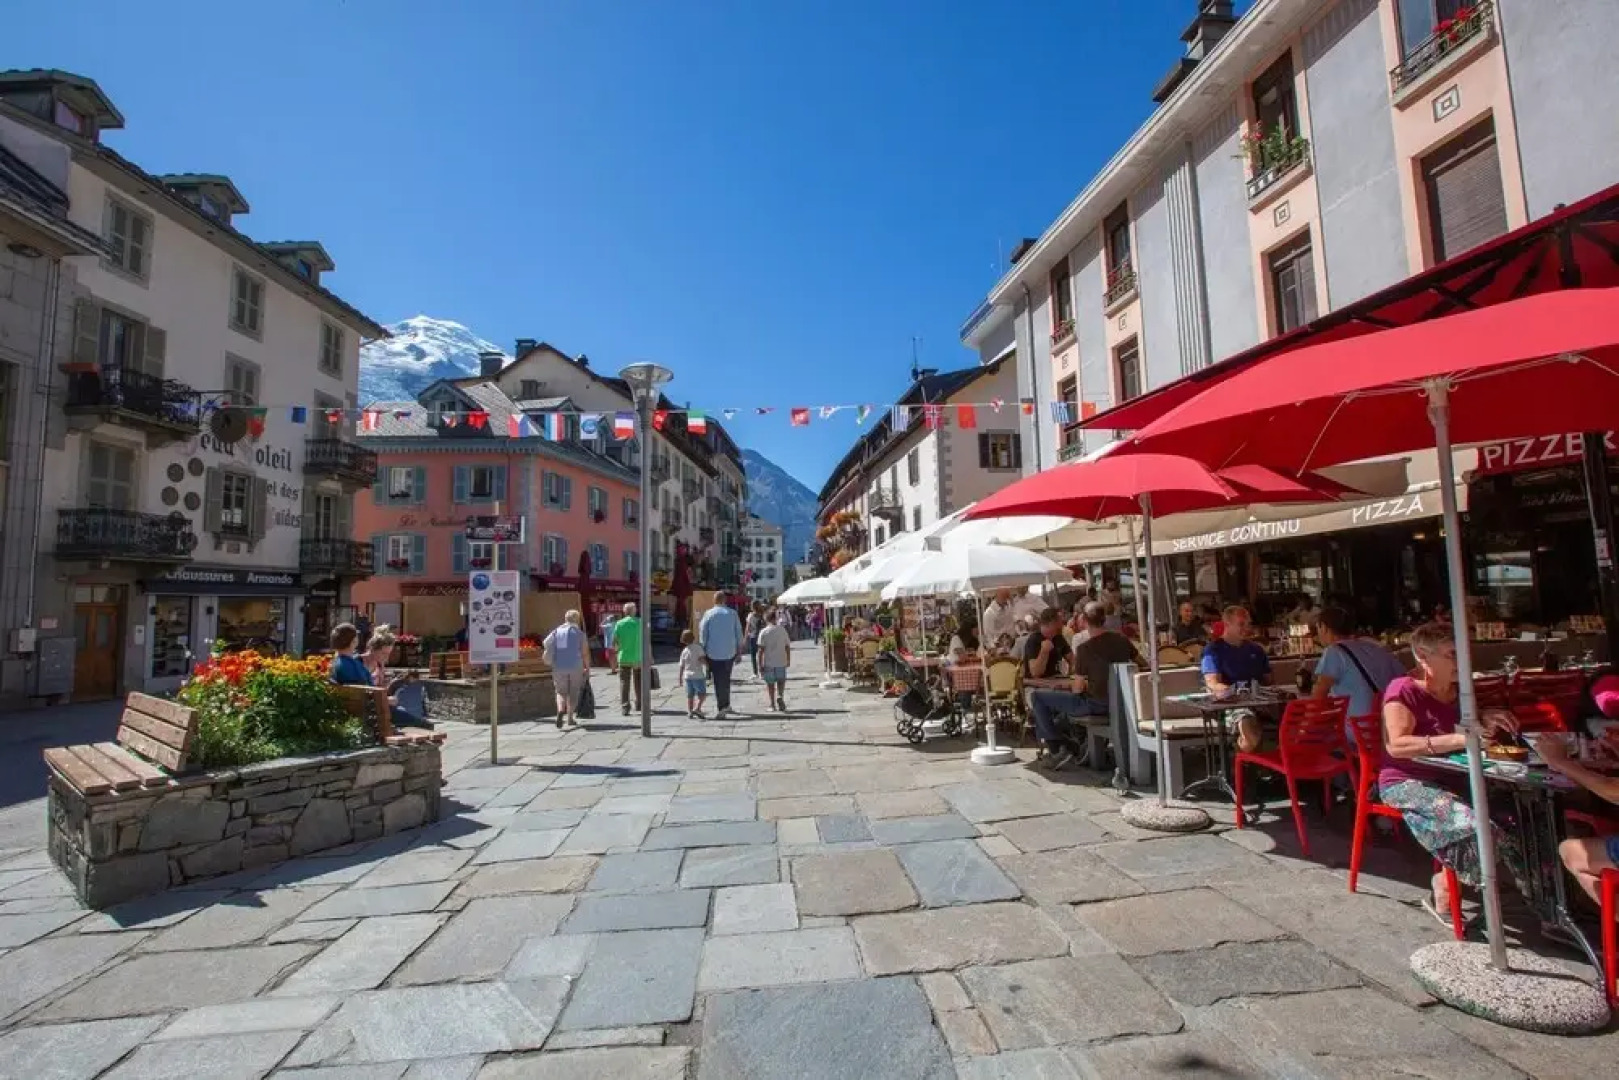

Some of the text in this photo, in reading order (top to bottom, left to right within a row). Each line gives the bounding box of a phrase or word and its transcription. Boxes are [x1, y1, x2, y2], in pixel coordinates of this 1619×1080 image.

[1351, 494, 1425, 524] PIZZA
[1172, 530, 1225, 552] SERVICE
[1230, 518, 1302, 543] CONTINU
[247, 572, 294, 584] Armando
